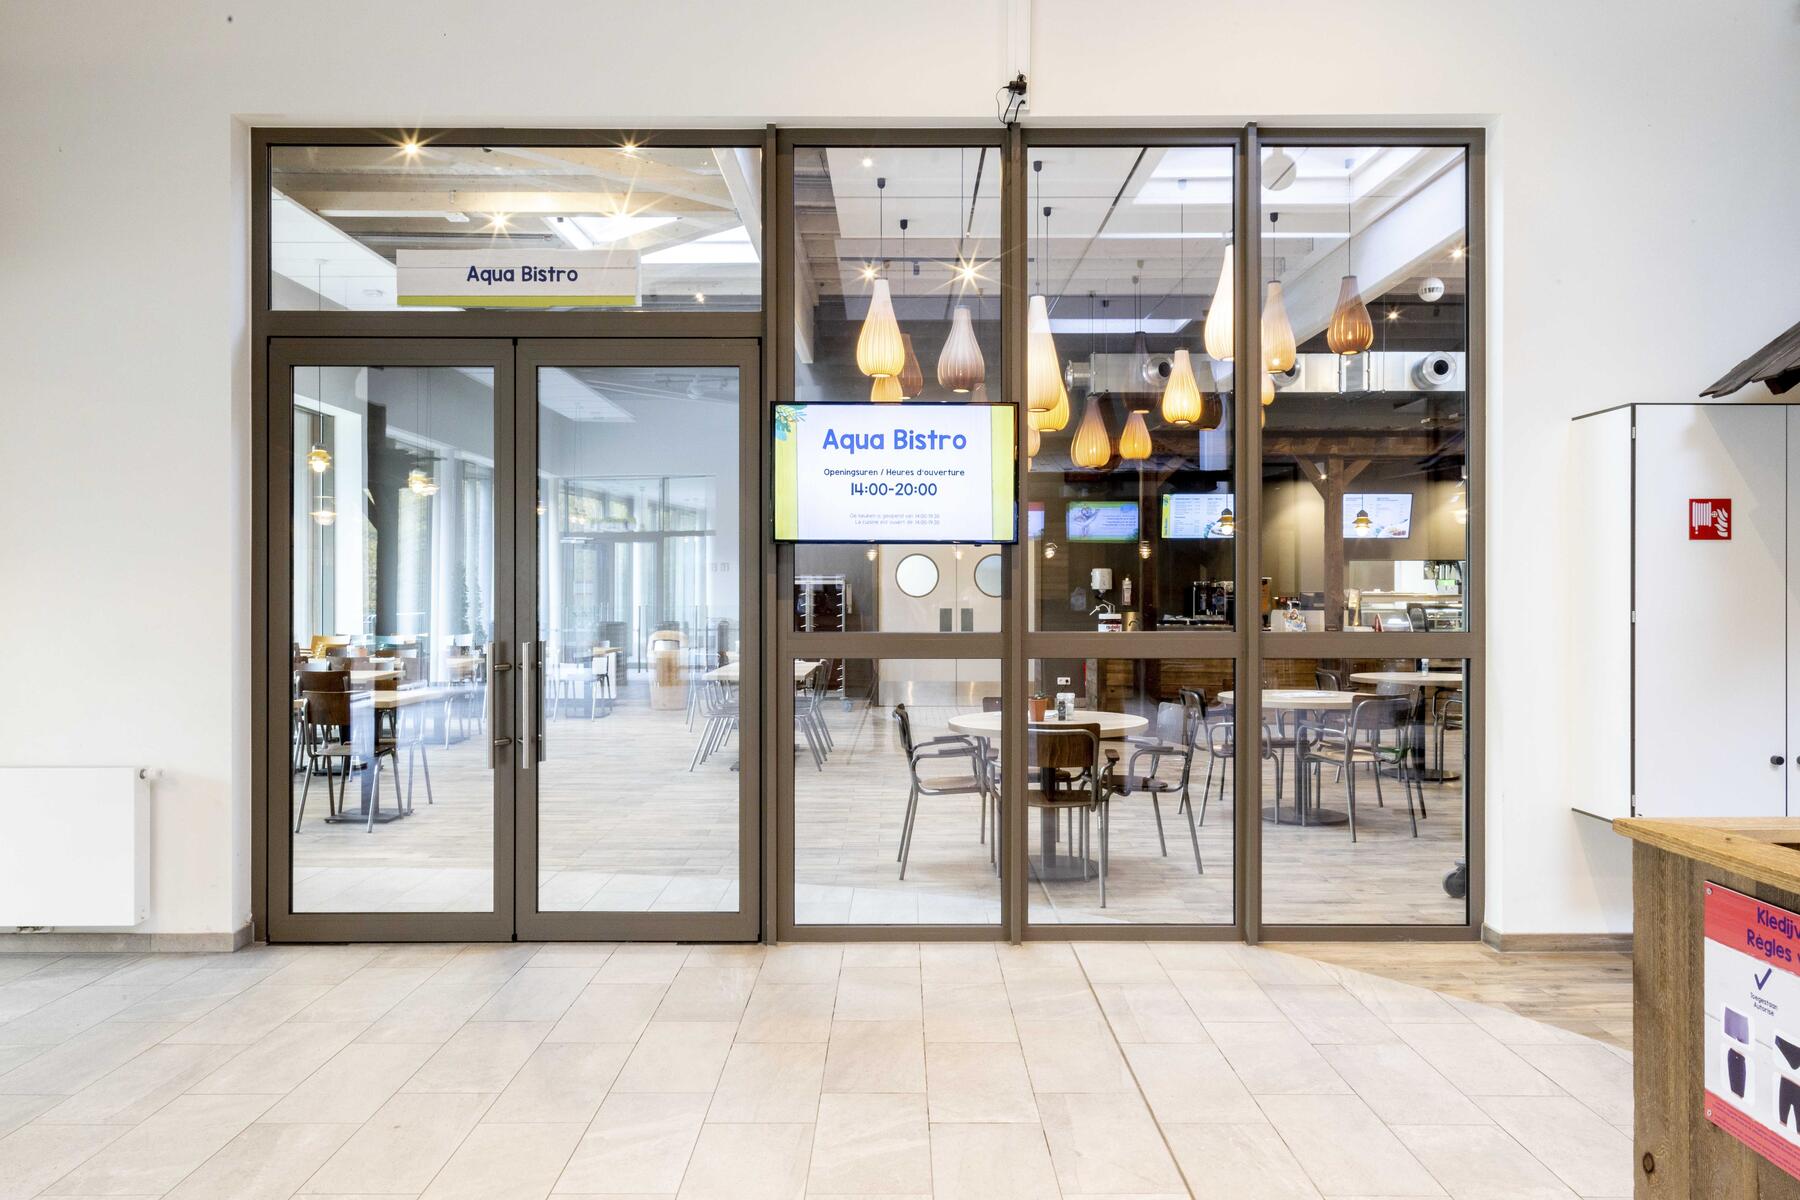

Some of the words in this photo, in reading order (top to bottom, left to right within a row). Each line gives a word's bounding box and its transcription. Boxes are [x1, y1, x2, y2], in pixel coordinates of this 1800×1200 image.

[467, 265, 515, 286] Aqua
[521, 265, 578, 282] Bistro
[822, 428, 884, 455] Aqua
[893, 428, 967, 450] Bistro
[823, 468, 879, 477] Openingsuren
[886, 468, 915, 476] Heures
[916, 468, 965, 476] d'ouverture
[850, 482, 938, 496] 14:00-20:00
